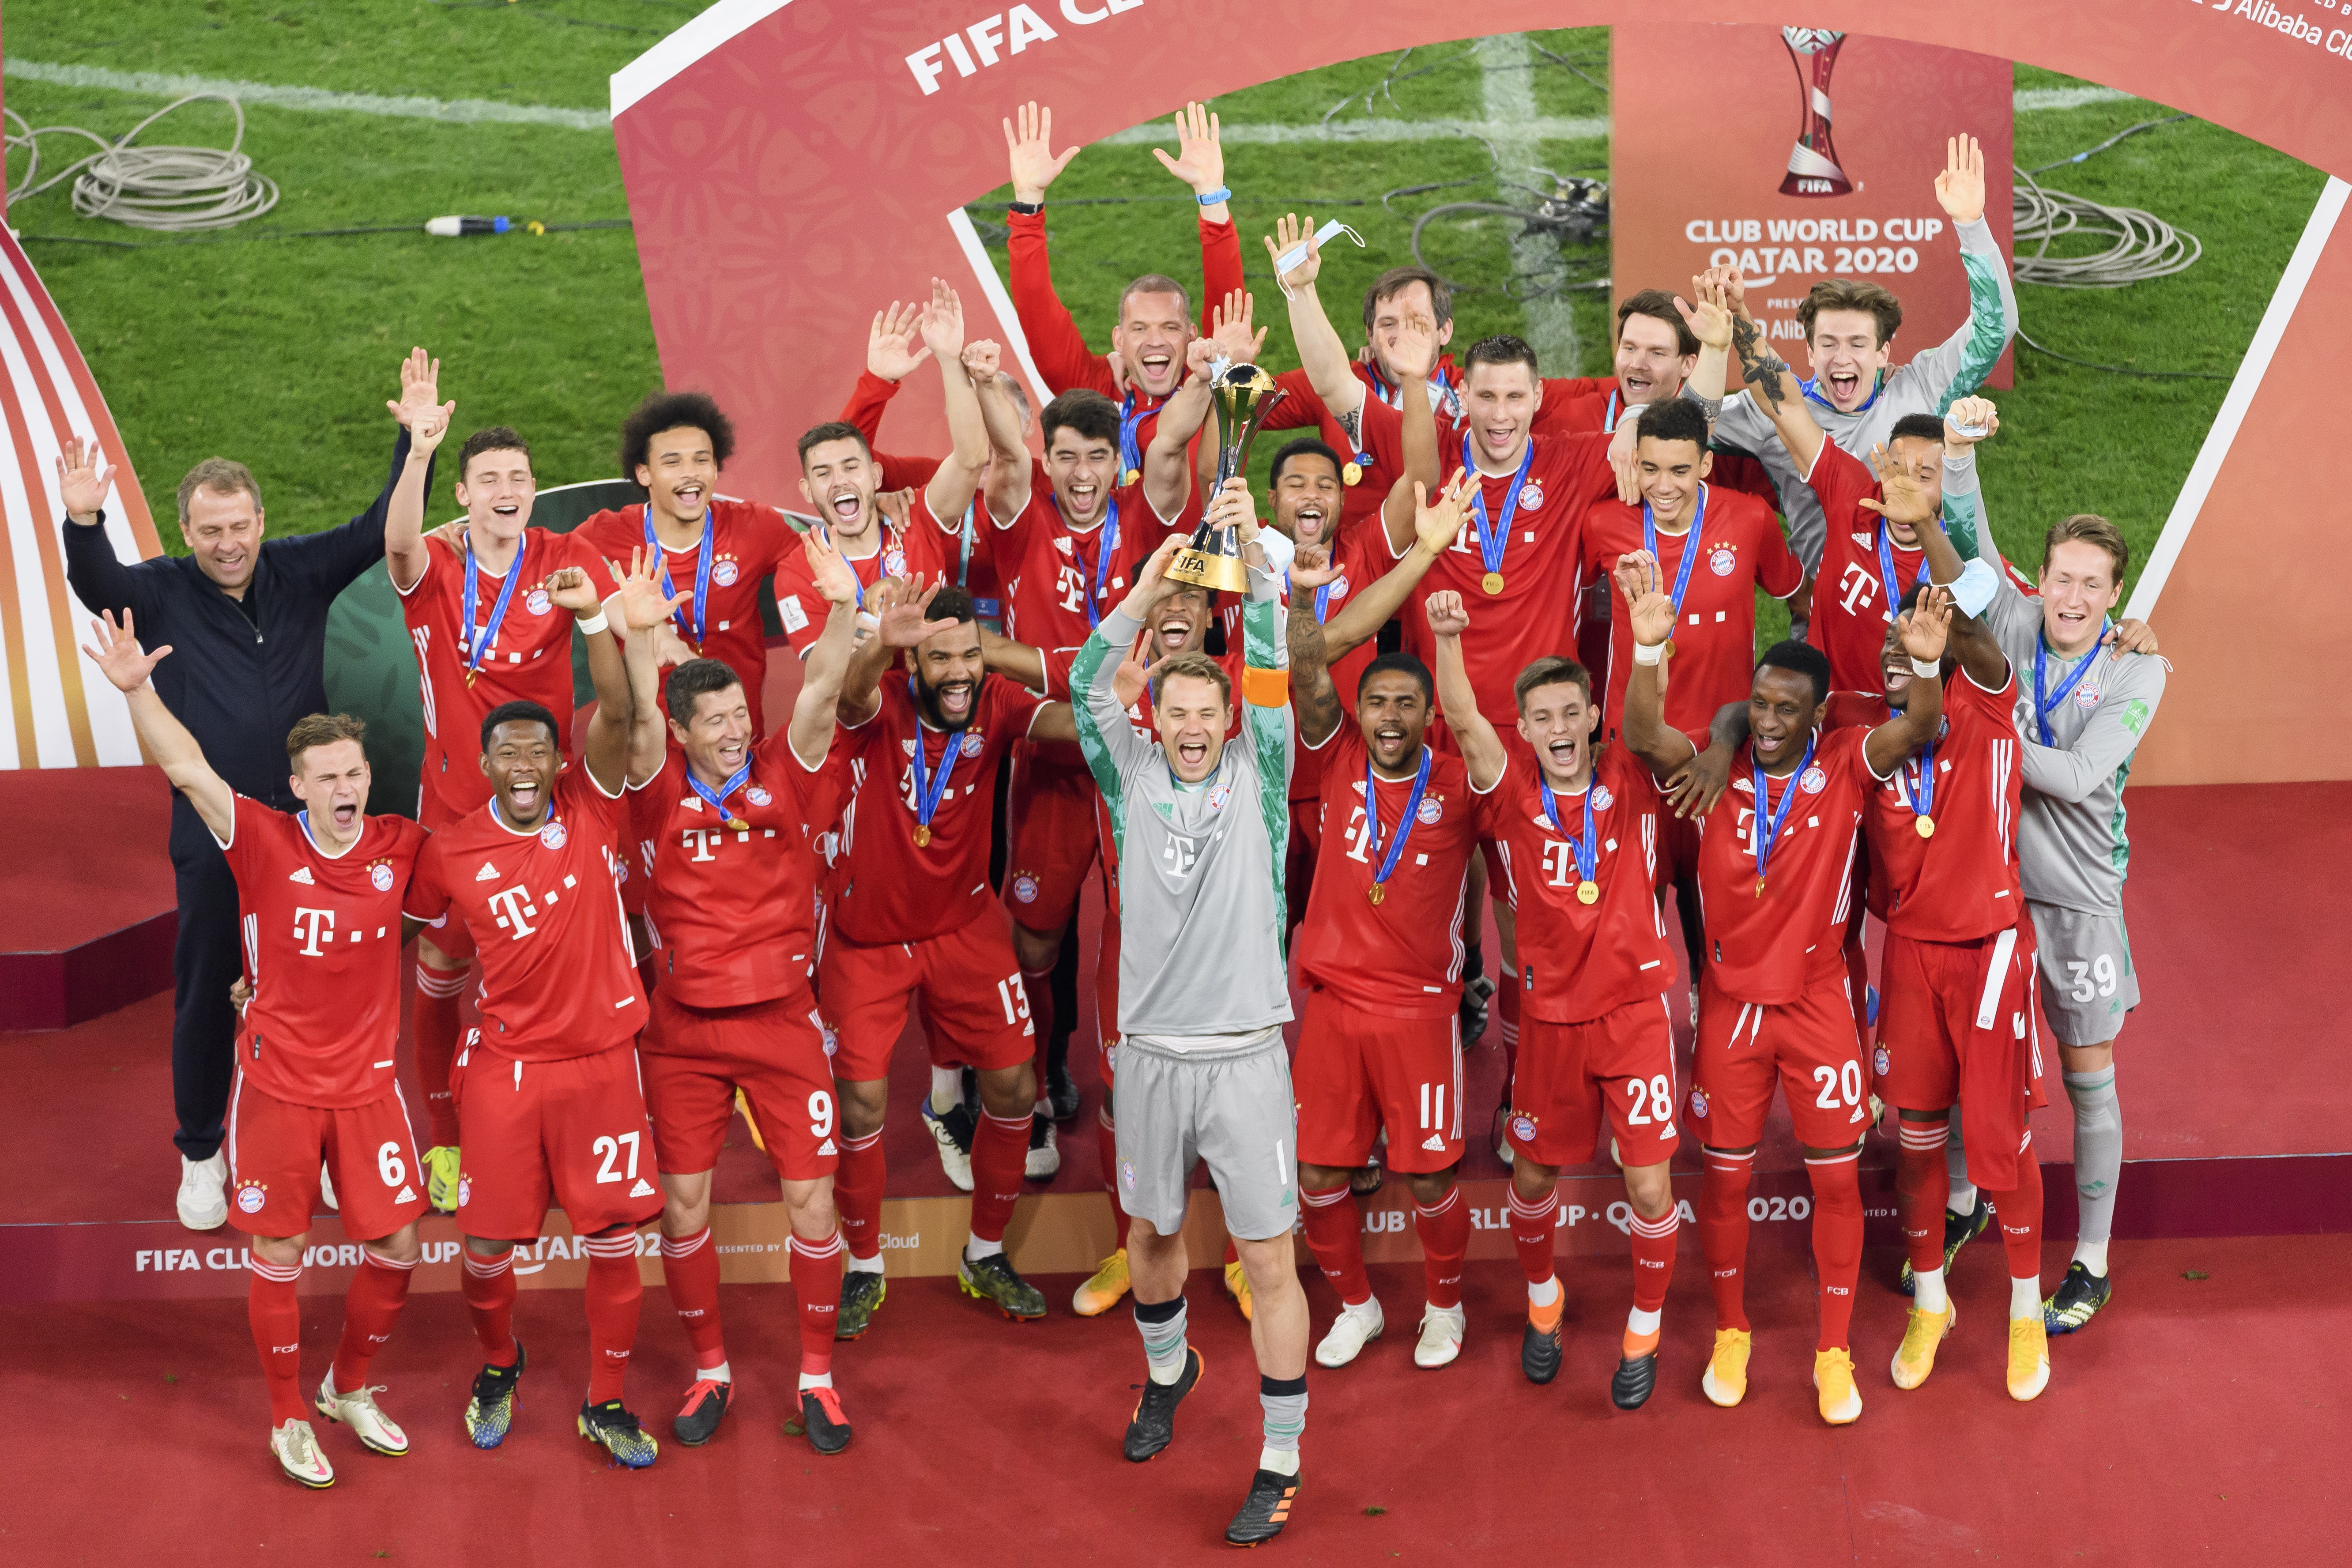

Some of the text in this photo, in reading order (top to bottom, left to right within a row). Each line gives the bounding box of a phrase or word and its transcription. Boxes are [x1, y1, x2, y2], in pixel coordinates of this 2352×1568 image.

[2234, 0, 2323, 45] Alibaba
[905, 4, 1058, 96] FIFA
[1798, 180, 1833, 192] FIFA
[1685, 218, 1943, 243] CLUB WORLD CUP
[1710, 246, 1919, 285] QATAR 2020
[1770, 319, 1806, 340] Alib
[1851, 533, 1872, 551] adidas
[1175, 555, 1204, 573] IFA
[1716, 551, 1733, 560] BAYERN
[2083, 684, 2099, 696] BAYERN
[488, 884, 537, 941] T
[294, 907, 335, 957] T
[2067, 954, 2117, 1003] 39
[998, 972, 1030, 1025] 13
[1814, 1060, 1861, 1109] 20
[1421, 1083, 1444, 1130] 11
[1627, 1074, 1673, 1125] 28
[808, 1090, 833, 1138] 9
[377, 1141, 406, 1187] 6
[592, 1131, 640, 1184] 27
[1276, 1138, 1288, 1185] 1
[1747, 1196, 1810, 1221] 020
[878, 1233, 919, 1250] Cloud
[2004, 1224, 2030, 1234] FCB
[136, 1249, 201, 1272] FIFA
[205, 1248, 253, 1270] CLU
[420, 1241, 461, 1264] UP
[511, 1235, 590, 1269] ATAR
[715, 1244, 763, 1254] RESENTED
[1637, 1258, 1665, 1269] FCB
[1715, 1268, 1737, 1278] FCB
[1827, 1286, 1849, 1295] FCB
[808, 1303, 834, 1312] FCB
[273, 1343, 298, 1353] FCB
